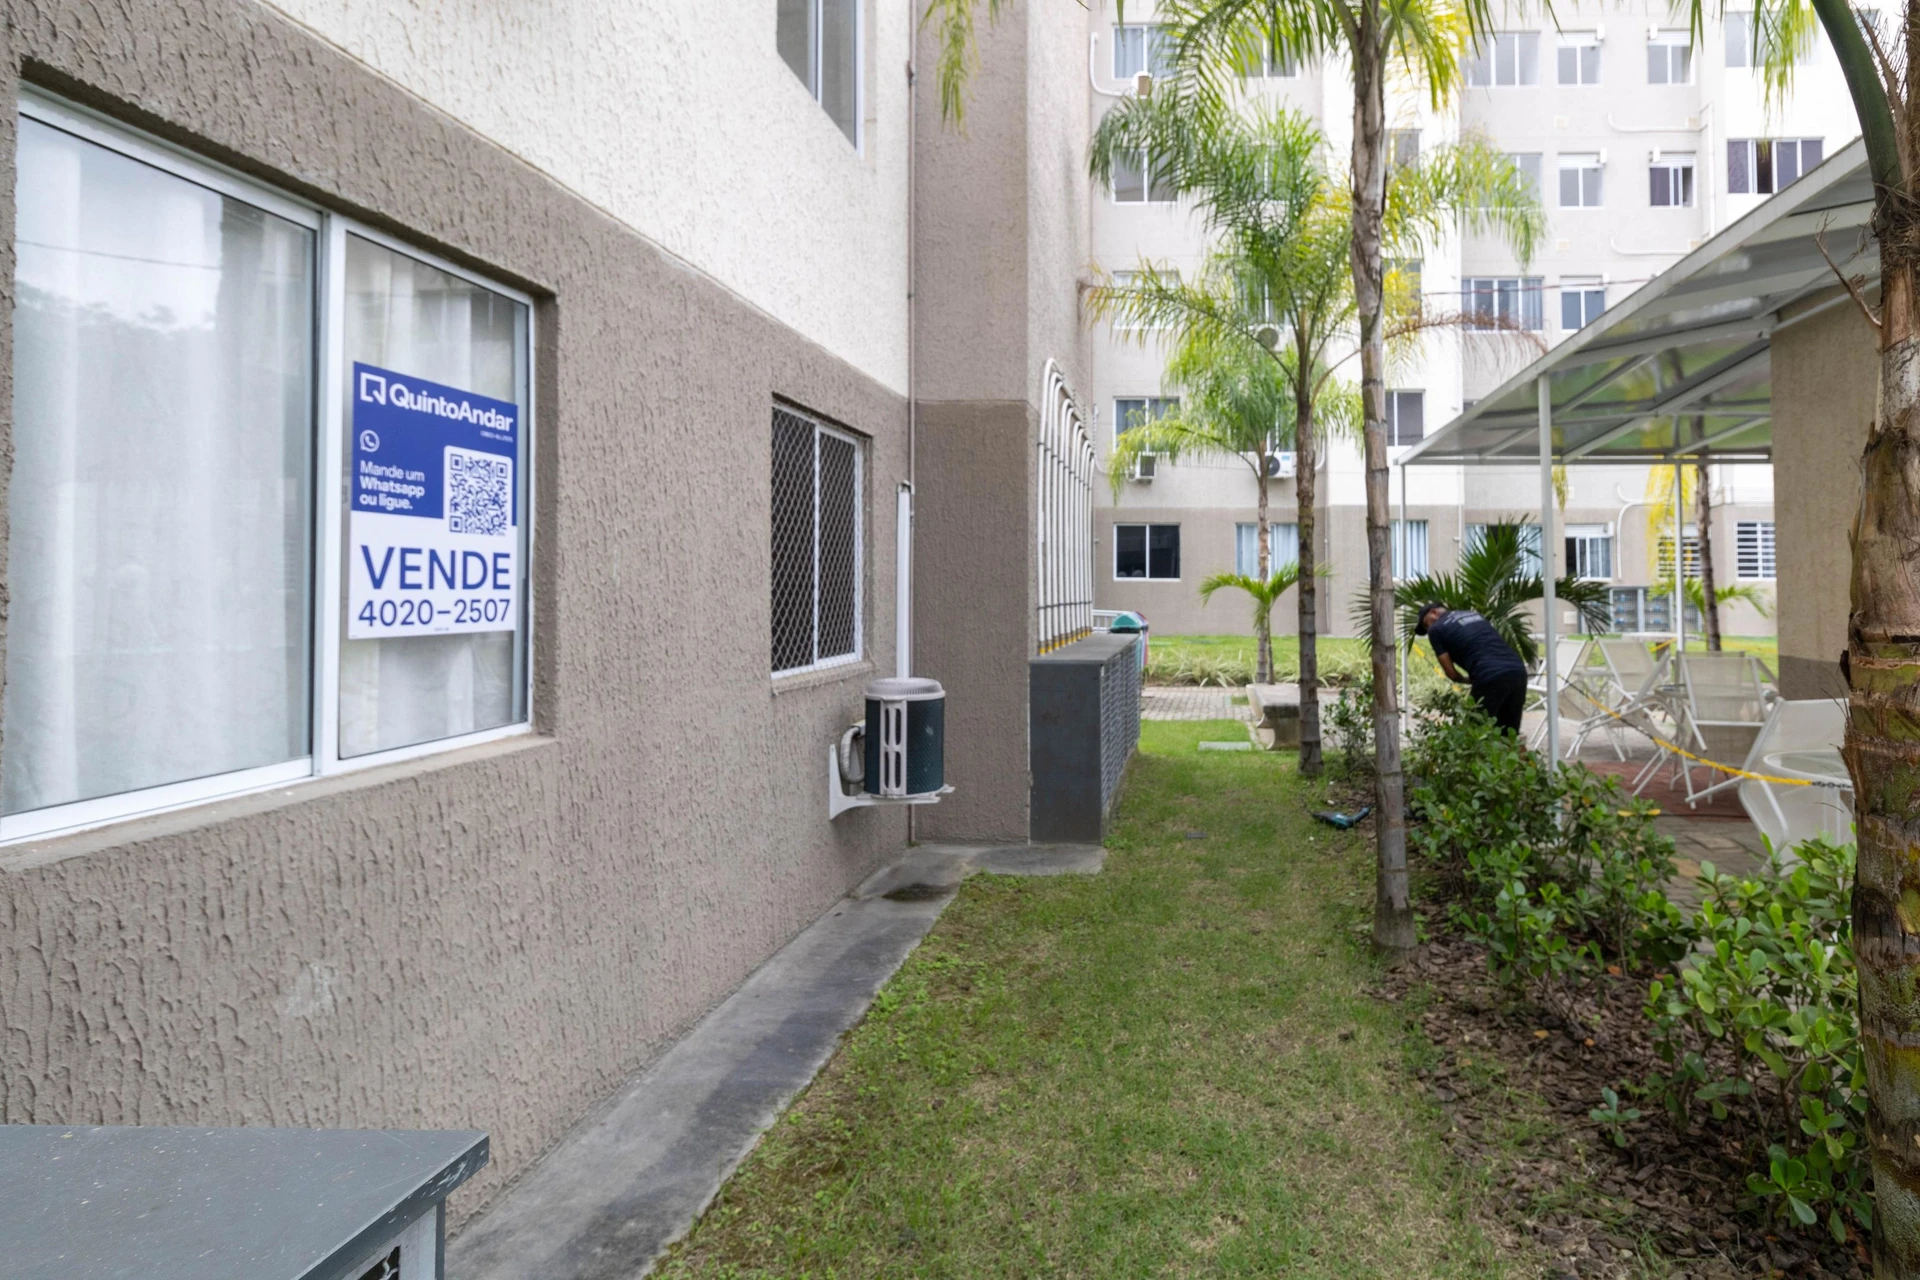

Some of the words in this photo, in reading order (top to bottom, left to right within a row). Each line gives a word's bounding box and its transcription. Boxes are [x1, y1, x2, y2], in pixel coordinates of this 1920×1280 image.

[389, 383, 513, 432] QuintoAndar
[360, 460, 404, 479] Mande
[405, 470, 425, 482] um
[359, 475, 425, 499] Whatsapp
[359, 494, 377, 506] ou
[379, 493, 413, 511] ligue.
[360, 544, 511, 590] VENDE
[358, 599, 511, 627] 4020-2507
